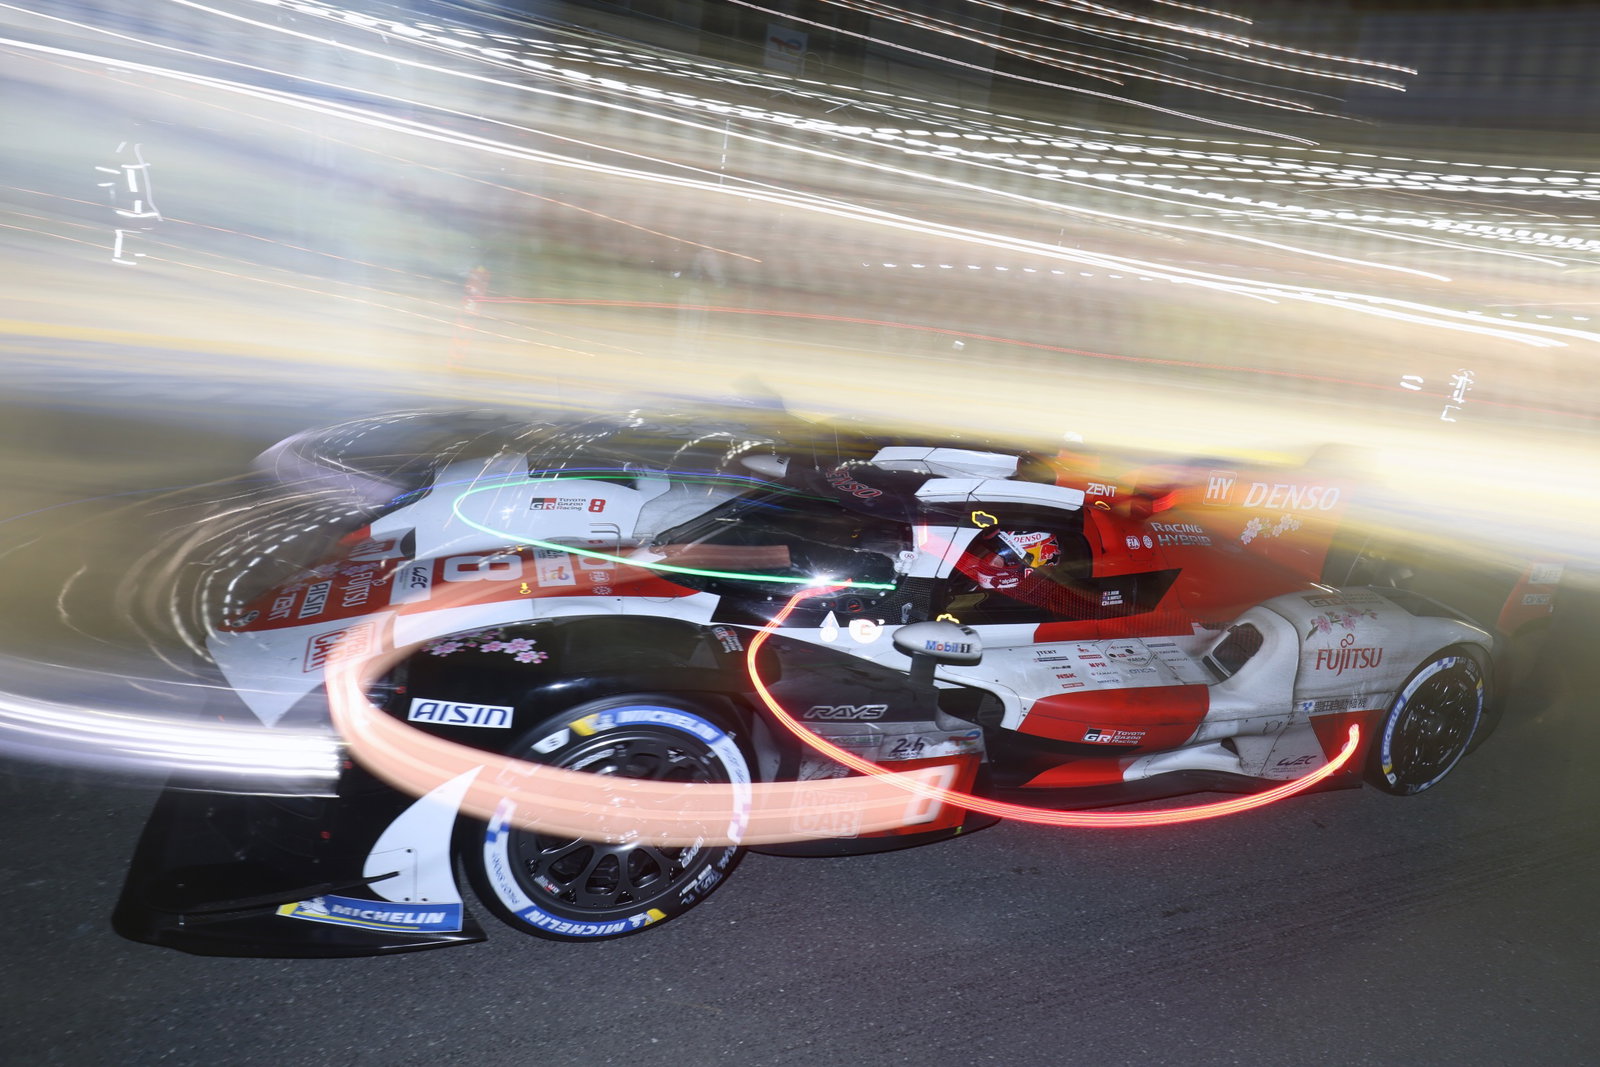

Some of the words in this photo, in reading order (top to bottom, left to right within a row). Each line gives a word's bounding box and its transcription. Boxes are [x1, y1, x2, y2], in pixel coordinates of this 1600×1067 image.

[1086, 482, 1117, 497] ZENT
[1206, 477, 1233, 500] HY
[1243, 482, 1341, 511] DENSO
[588, 499, 606, 512] 8
[1151, 522, 1204, 533] RACING
[1014, 534, 1041, 543] DENSO
[1157, 534, 1212, 546] HYBRID
[411, 566, 427, 588] WEC
[443, 555, 522, 582] 8
[301, 583, 329, 616] AISIN
[340, 571, 373, 607] FUJITSU
[925, 640, 958, 653] Mobil
[1315, 648, 1383, 676] FUJITSU
[414, 702, 507, 726] AISIN
[804, 704, 888, 719] RAYS
[616, 709, 721, 741] MICHELIN
[1083, 733, 1112, 743] GR
[1277, 755, 1317, 766] WEC
[330, 904, 447, 924] MICHELIN
[524, 909, 627, 936] MICHELIN
